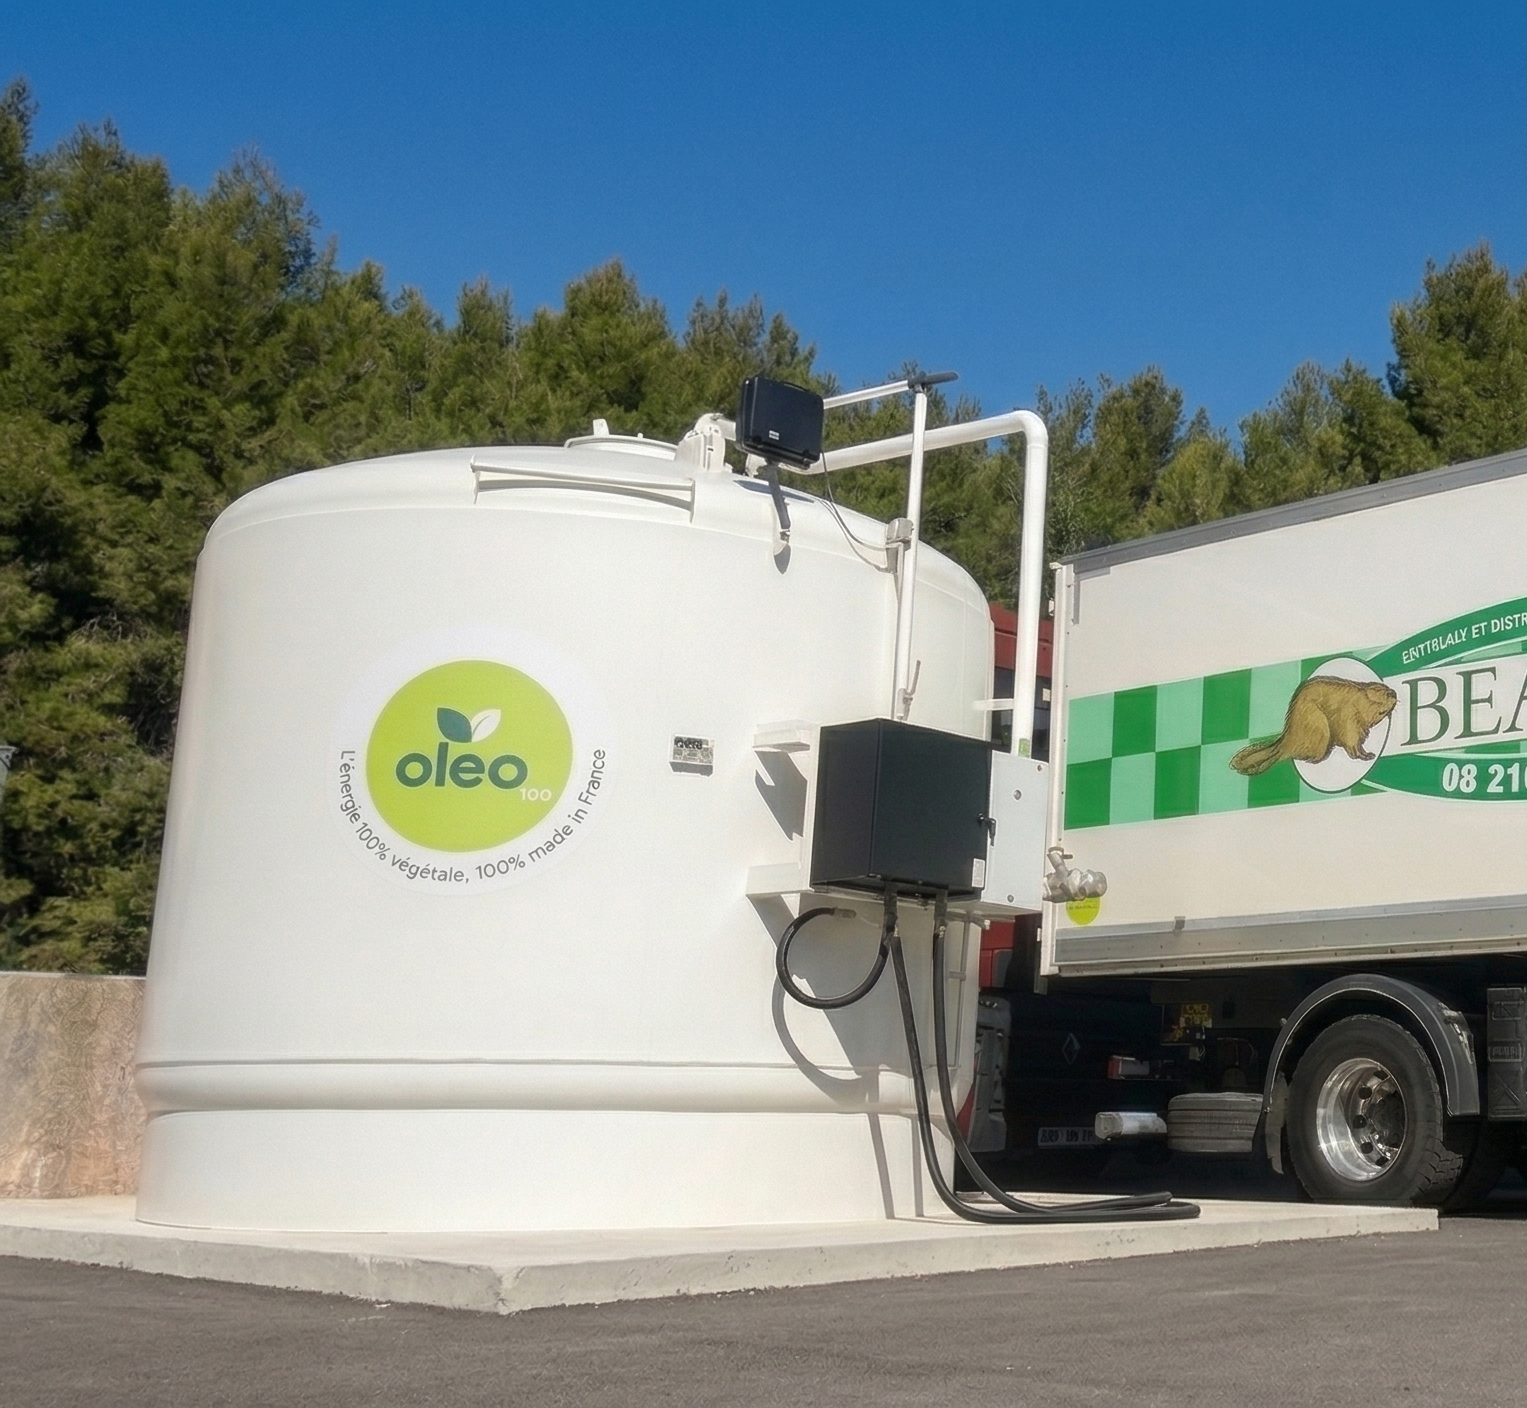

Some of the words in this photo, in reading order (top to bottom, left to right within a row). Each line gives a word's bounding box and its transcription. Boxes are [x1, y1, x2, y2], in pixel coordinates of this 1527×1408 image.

[1471, 622, 1488, 639] ET
[395, 741, 528, 790] oleo
[577, 749, 606, 806] France
[1442, 762, 1478, 793] 08
[339, 750, 362, 824] L'énergie
[519, 787, 552, 801] 100
[567, 808, 588, 824] in
[355, 822, 391, 861] 100%
[527, 825, 574, 862] made
[391, 854, 470, 884] végétale,
[475, 854, 526, 880] 100%
